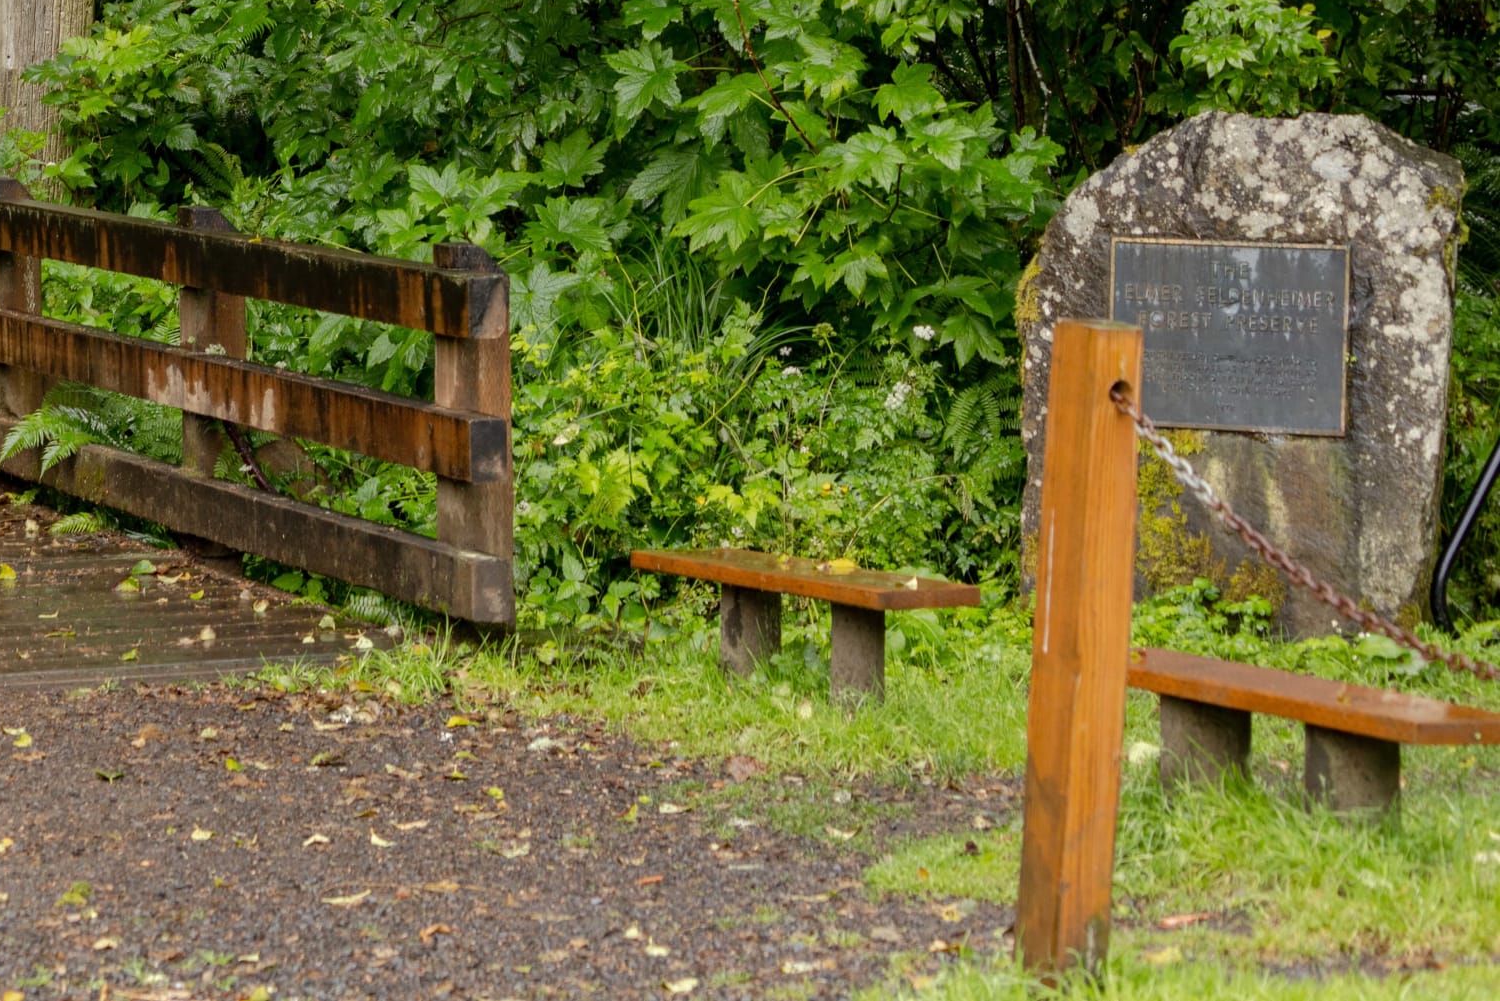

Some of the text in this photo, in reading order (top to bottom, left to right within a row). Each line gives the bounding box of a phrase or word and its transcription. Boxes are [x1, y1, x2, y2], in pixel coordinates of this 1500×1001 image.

[1211, 260, 1250, 279] THE
[1126, 283, 1183, 304] ELMER
[1140, 310, 1319, 333] FOREST PRESERVE
